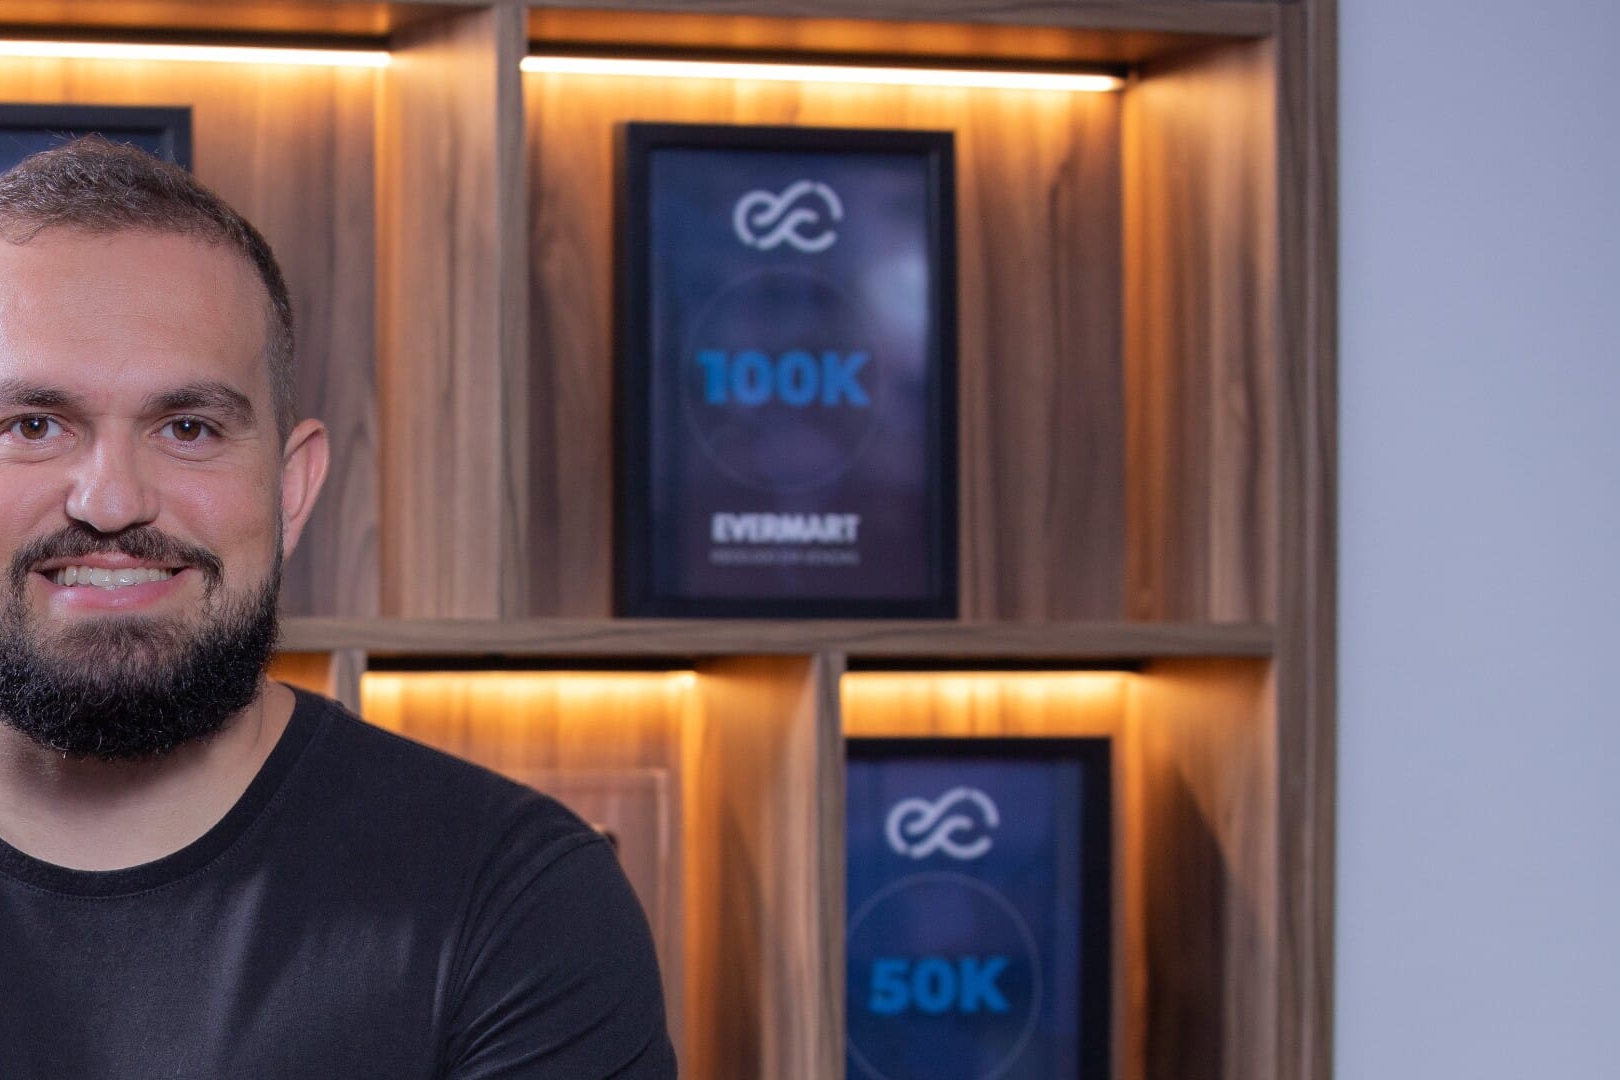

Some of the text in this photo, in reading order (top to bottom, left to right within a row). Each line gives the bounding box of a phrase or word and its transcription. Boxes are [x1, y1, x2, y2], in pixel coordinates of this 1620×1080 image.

[697, 349, 870, 405] 100K
[712, 512, 860, 543] EVERMART
[868, 956, 1010, 1015] 50K
